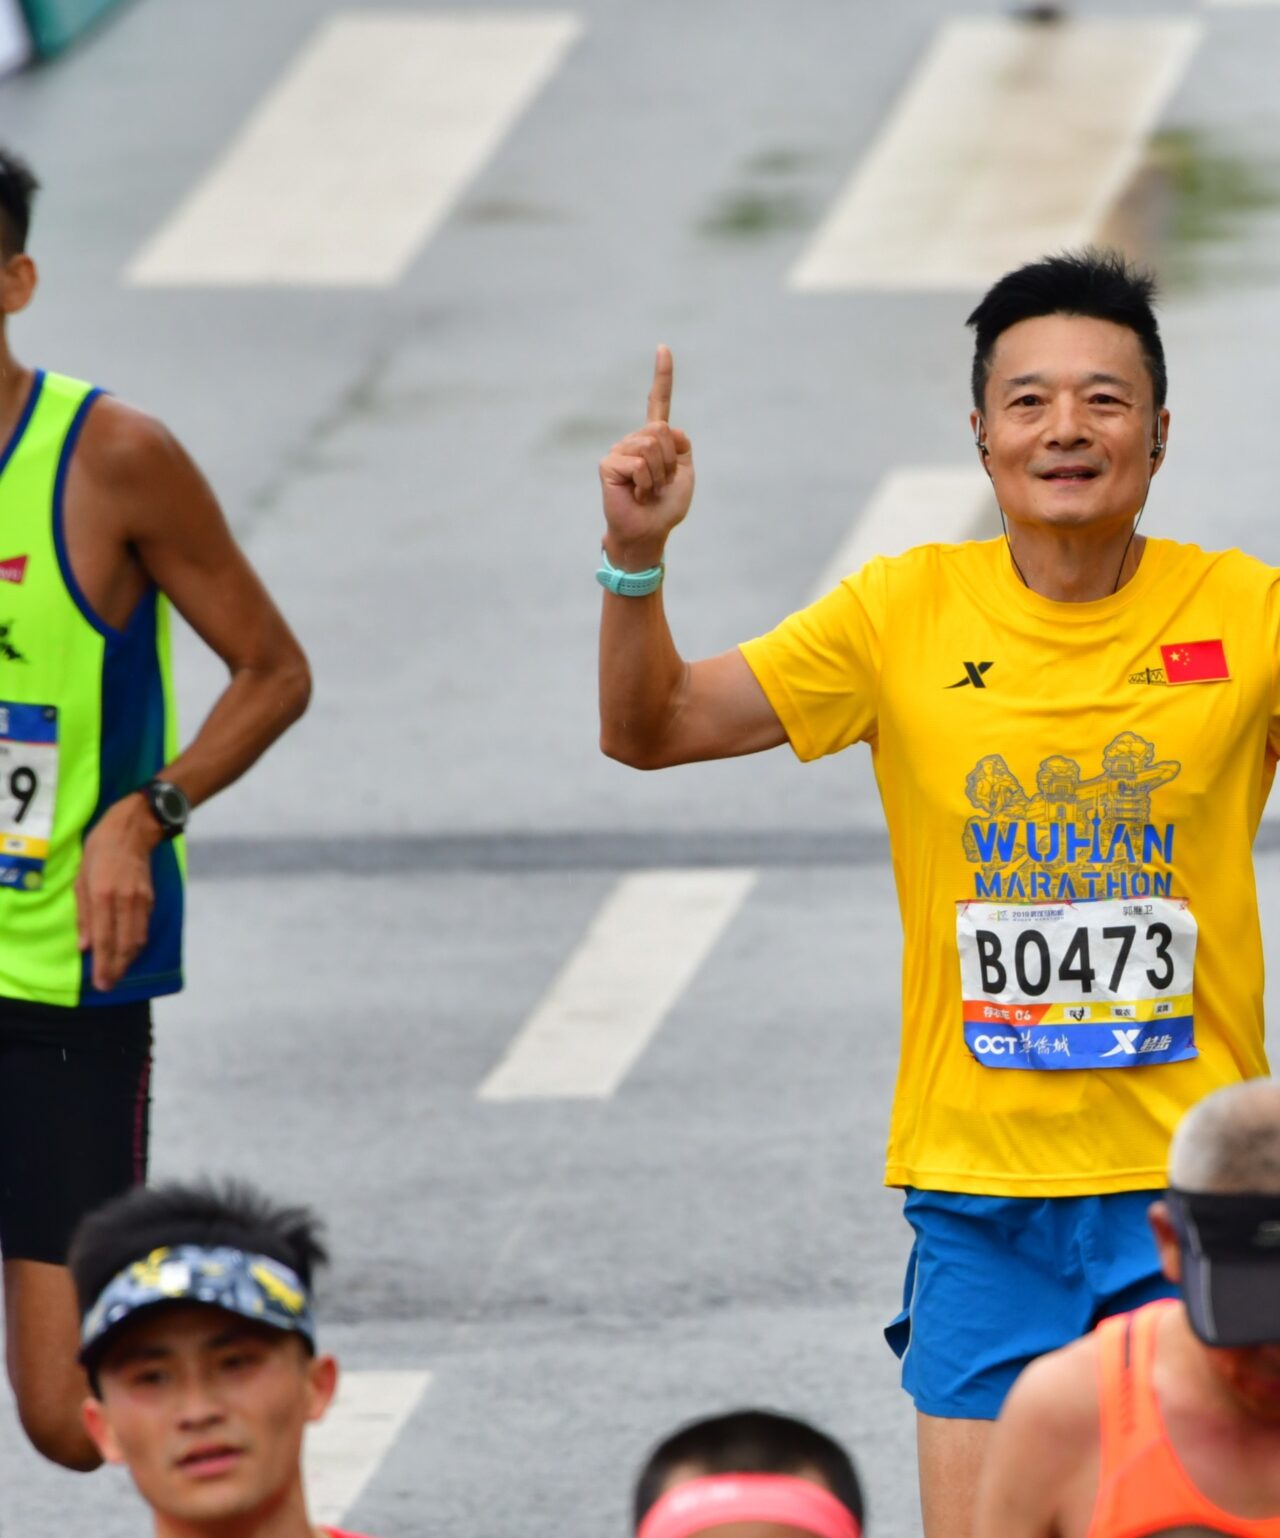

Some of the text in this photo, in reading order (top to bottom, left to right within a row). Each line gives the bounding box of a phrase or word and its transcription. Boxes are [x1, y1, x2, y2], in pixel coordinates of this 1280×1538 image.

[970, 818, 1175, 864] WUHAN
[974, 871, 1173, 899] MARATHON
[975, 922, 1175, 997] B0473
[974, 1034, 1018, 1055] OCT
